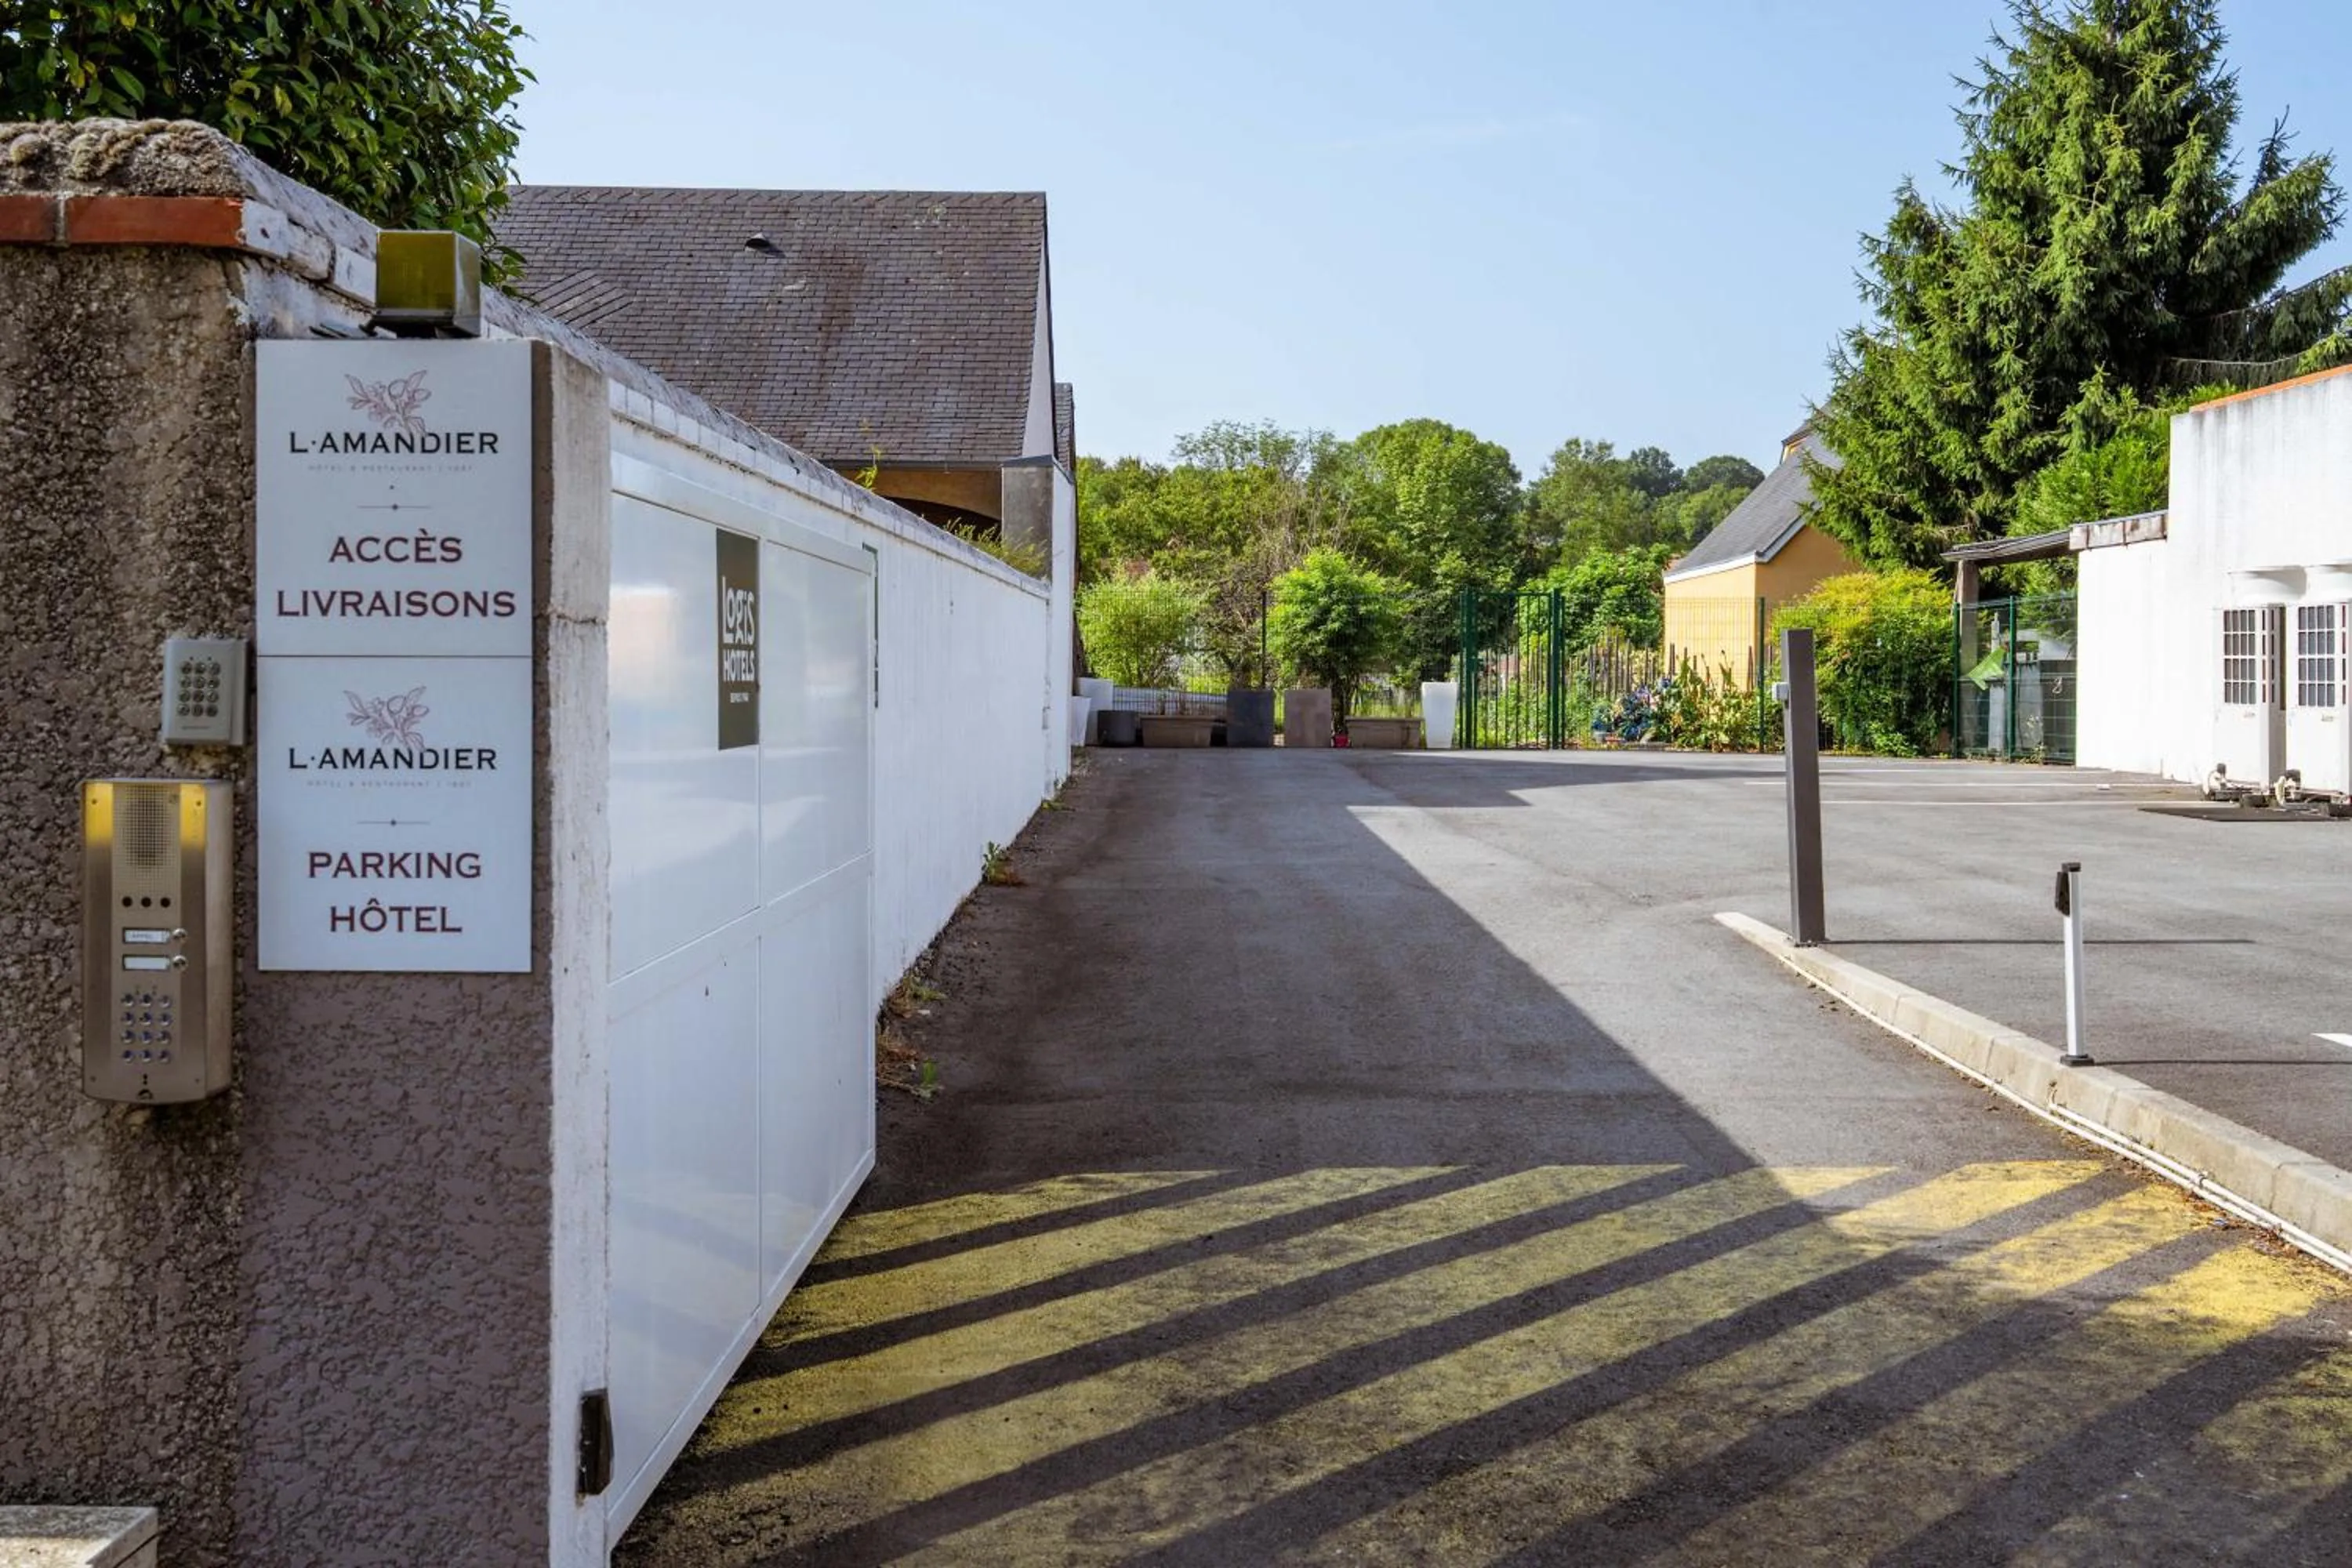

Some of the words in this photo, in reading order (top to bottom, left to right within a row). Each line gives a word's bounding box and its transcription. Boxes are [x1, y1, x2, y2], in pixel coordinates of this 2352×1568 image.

[328, 528, 463, 564] ACCÈS
[277, 590, 517, 618] LIVRAISONS
[723, 648, 755, 682] HOTELS
[308, 851, 482, 879] PARKING
[329, 898, 463, 933] HÔTEL
